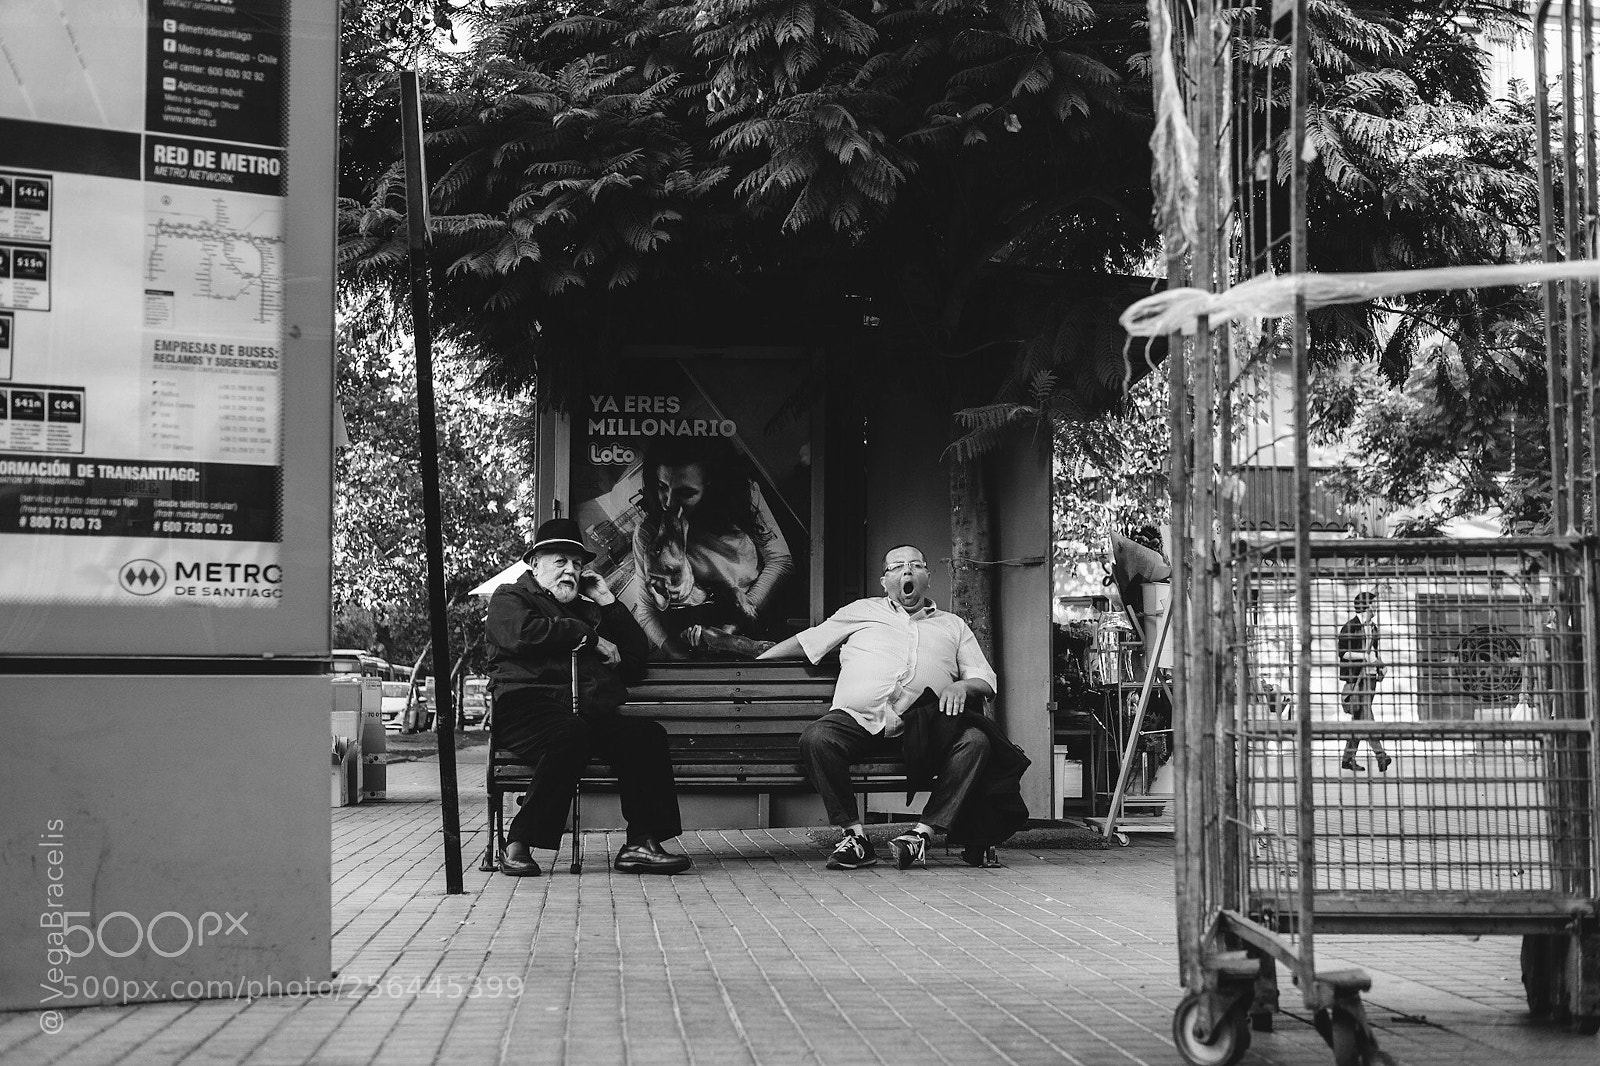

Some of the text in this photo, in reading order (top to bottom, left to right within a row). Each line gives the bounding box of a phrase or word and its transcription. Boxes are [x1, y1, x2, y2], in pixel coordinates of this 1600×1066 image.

[178, 23, 252, 42] @metrodesantiago
[178, 43, 202, 55] Metro
[203, 47, 214, 57] de
[215, 48, 251, 62] Santiago
[257, 53, 278, 65] Chile
[163, 59, 178, 70] Call
[154, 144, 280, 176] RED DE METRO
[154, 165, 234, 183] METRO NETWORK
[154, 339, 279, 359] EMPRESAS DE BUSES:
[153, 353, 203, 365] RECLAMOS
[206, 356, 212, 366] Y
[214, 357, 279, 370] SUGERENCIAS
[590, 395, 681, 414] YA ERES
[588, 418, 737, 438] MILLONARIO
[77, 463, 95, 478] DE
[97, 464, 200, 482] TRANSANTIAGO:
[53, 516, 68, 529] 73
[87, 517, 102, 530] 73
[184, 521, 203, 534] 730
[220, 523, 233, 535] 73
[175, 561, 283, 584] METRO
[175, 586, 196, 596] DE
